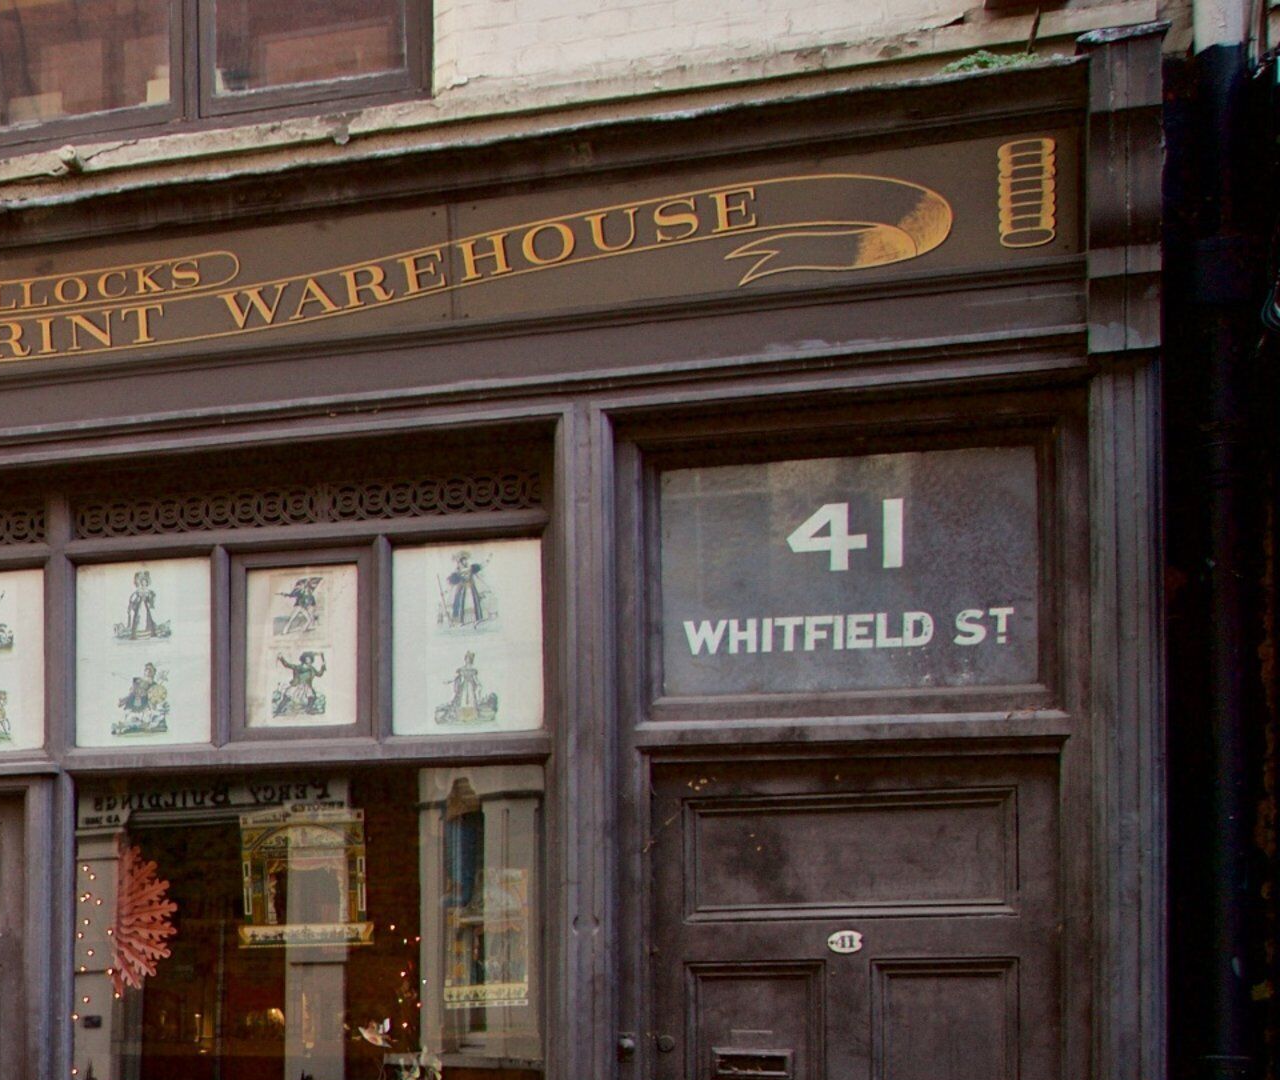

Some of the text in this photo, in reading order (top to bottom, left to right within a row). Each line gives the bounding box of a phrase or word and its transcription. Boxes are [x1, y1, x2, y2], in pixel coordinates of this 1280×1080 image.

[218, 187, 758, 330] WAREHOUSE
[786, 498, 904, 571] 41
[683, 611, 935, 656] WHITFIELD
